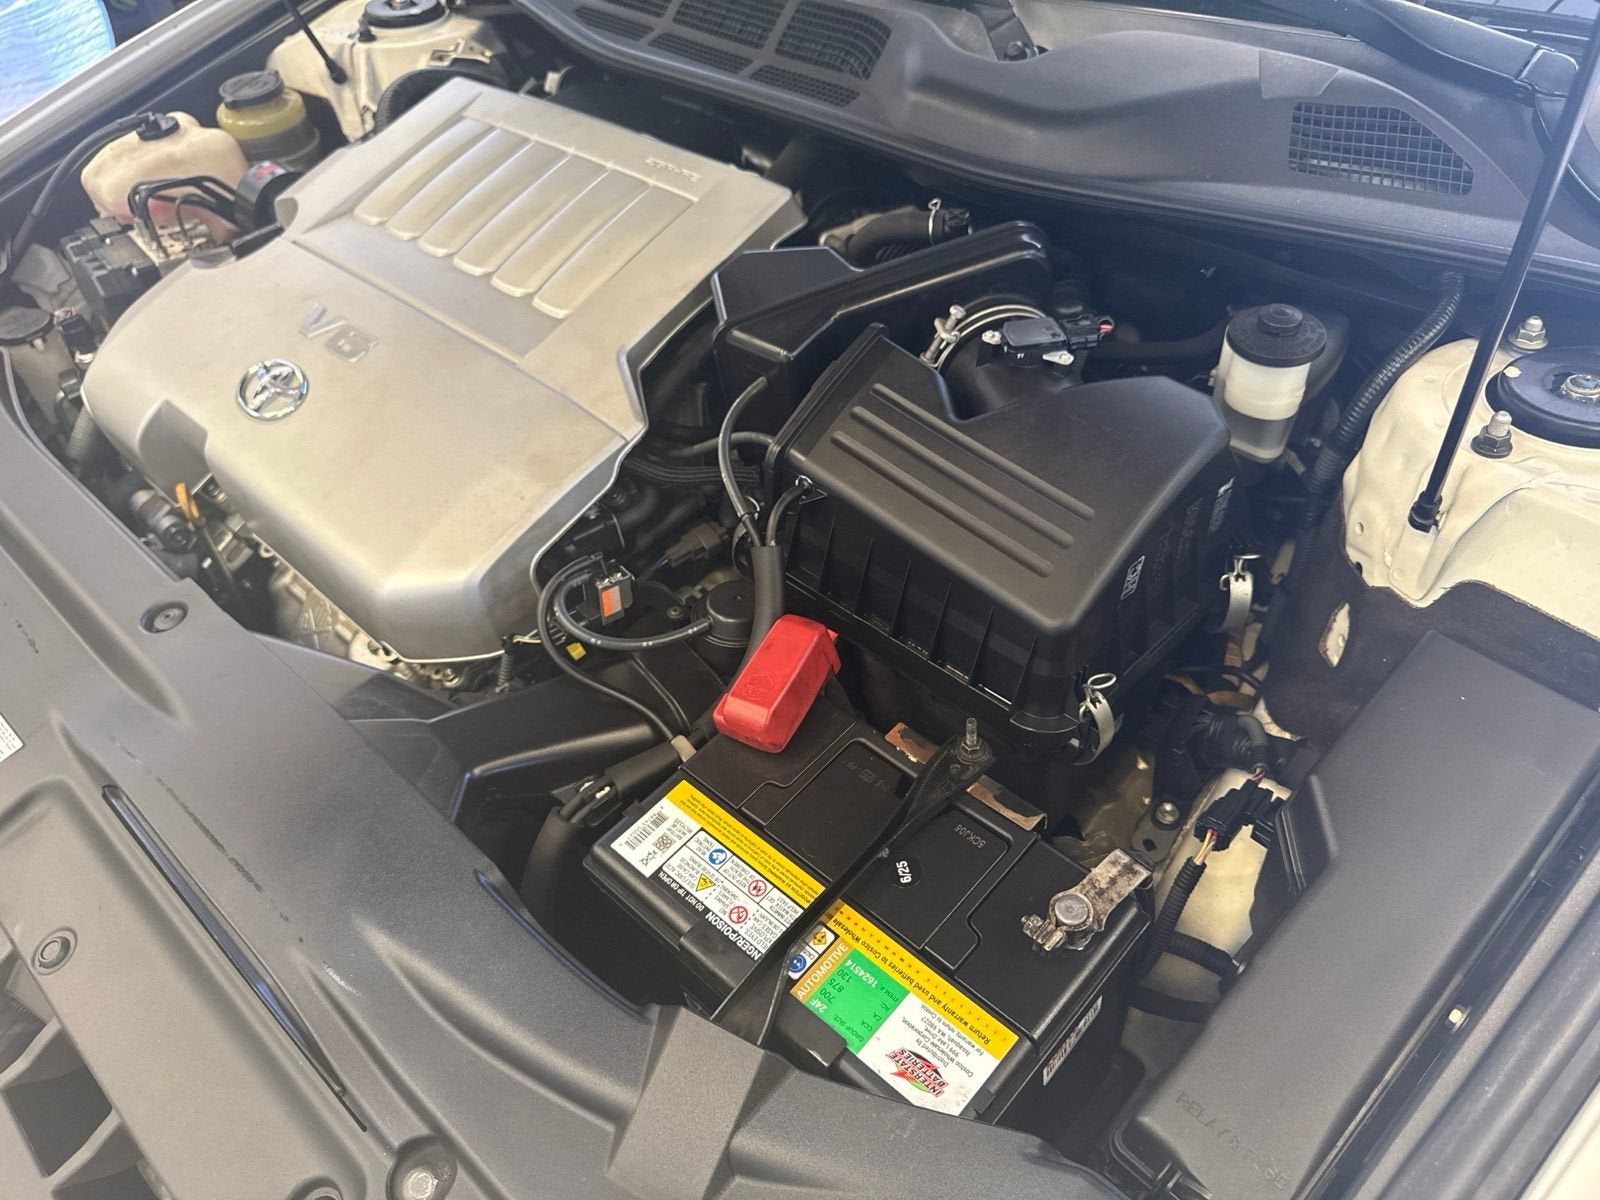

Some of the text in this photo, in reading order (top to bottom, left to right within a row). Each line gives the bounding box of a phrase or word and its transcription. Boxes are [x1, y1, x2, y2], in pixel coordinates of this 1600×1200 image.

[297, 300, 379, 364] V6
[896, 860, 912, 883] 6/25
[669, 880, 680, 890] OR
[675, 886, 687, 896] TIP
[684, 893, 698, 905] NOT
[693, 901, 705, 911] DO
[703, 910, 762, 960] NGER/POISON
[749, 923, 774, 944] XPLOSIVE
[795, 941, 848, 1000] AUTOMOTIVE
[835, 967, 853, 983] 130
[843, 958, 879, 988] 1624514
[826, 976, 845, 993] 875
[830, 917, 991, 1045] Return warranty and used batteries to Costco Wholesale
[818, 986, 836, 1003] 700
[882, 988, 899, 1002] ITEM
[809, 996, 828, 1013] 24F
[844, 1024, 865, 1042] GROUP
[935, 1027, 947, 1038] WA
[940, 1020, 956, 1034] return
[913, 1036, 949, 1067] Distributed by
[928, 1039, 956, 1063] Wholesale
[935, 1036, 950, 1050] Lake
[947, 1046, 960, 1057] 999
[973, 1046, 984, 1056] For
[890, 1052, 945, 1097] INTERSTATE
[900, 1050, 949, 1088] BATTERIES
[953, 1059, 974, 1078] Costco
